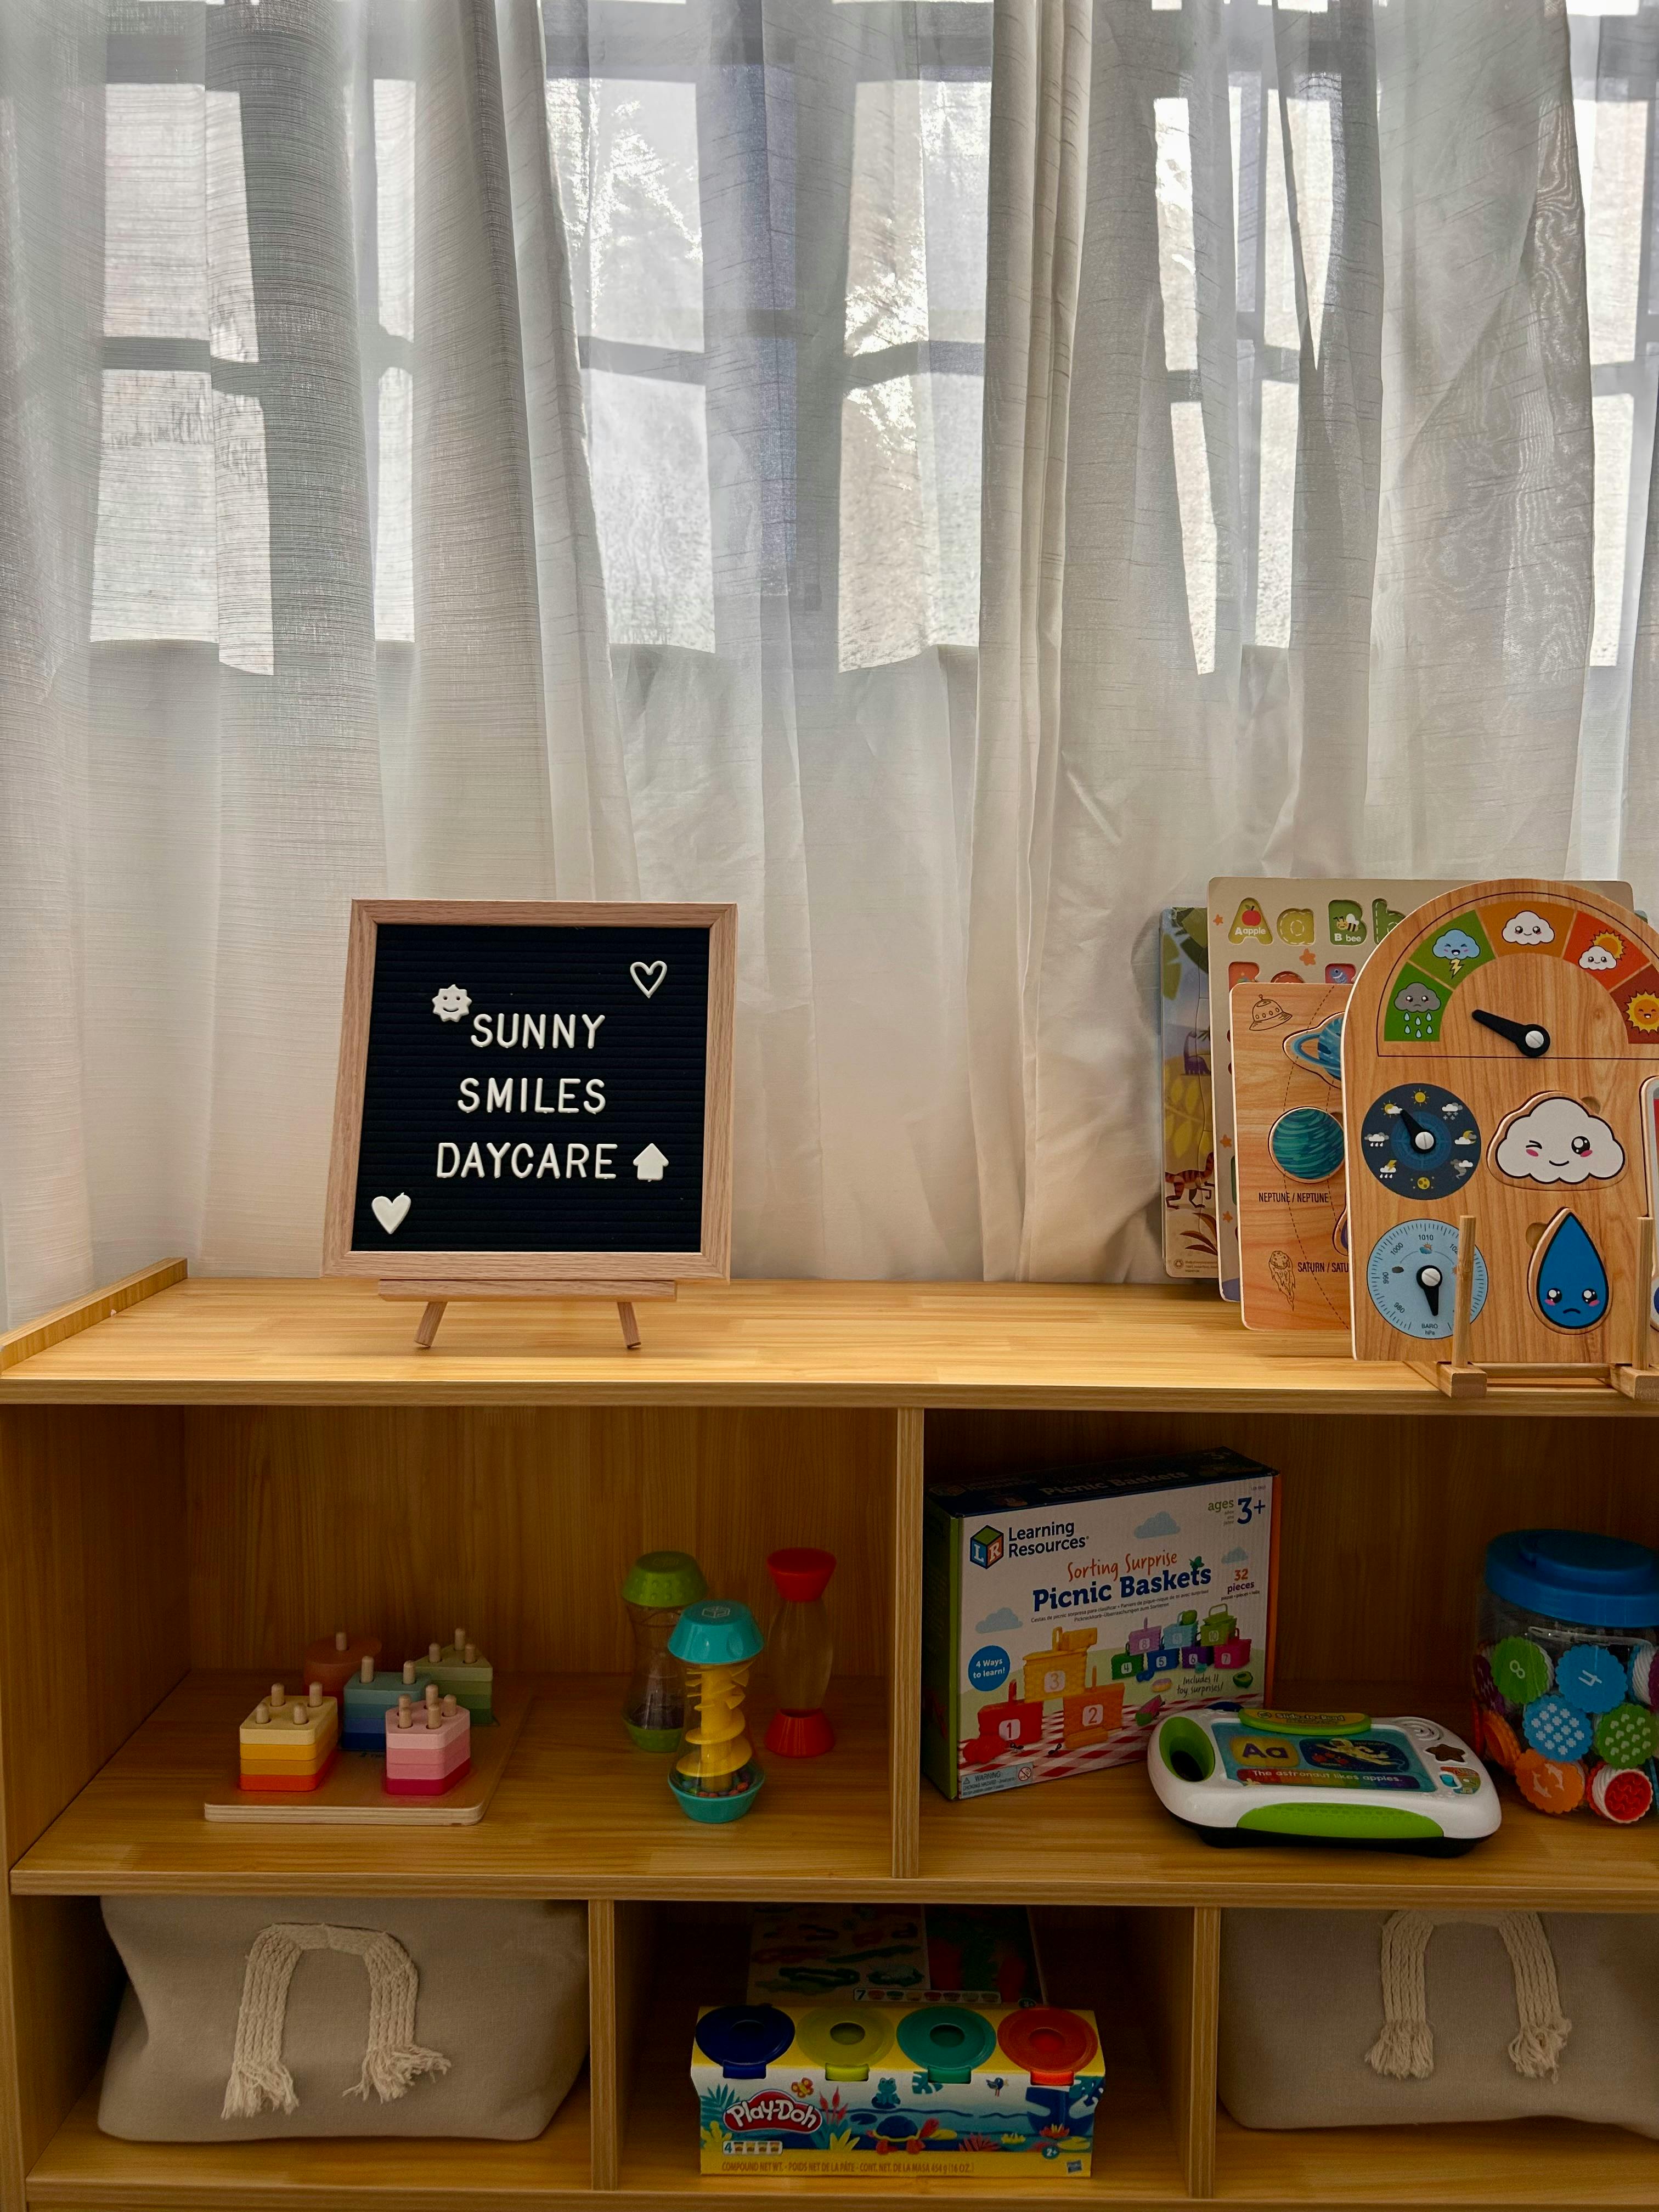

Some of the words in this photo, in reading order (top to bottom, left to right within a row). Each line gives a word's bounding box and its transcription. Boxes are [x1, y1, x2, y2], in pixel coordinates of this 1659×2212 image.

[1243, 927, 1266, 936] apple
[1334, 933, 1342, 941] B
[1346, 934, 1361, 943] bee
[470, 1013, 606, 1049] SUNNY
[458, 1077, 606, 1114] SMILES
[437, 1142, 618, 1179] DAYCARE
[1259, 1192, 1290, 1203] NEPTUNE
[1297, 1193, 1329, 1203] NEPTUNE
[1390, 1242, 1403, 1255] 1000
[1298, 1262, 1324, 1273] SATURN
[1393, 1302, 1405, 1314] 980
[1038, 1481, 1109, 1496] Picnic
[1109, 1471, 1189, 1487] Baskets
[1208, 1500, 1234, 1513] ages
[1237, 1497, 1265, 1524] 3+
[1009, 1521, 1074, 1542] Learning
[1068, 1558, 1118, 1582] Sorting
[1125, 1549, 1177, 1576] Surprise
[1234, 1568, 1248, 1581] 32
[1033, 1581, 1111, 1612] Picnic
[1120, 1567, 1211, 1598] Baskets
[1227, 1581, 1255, 1594] pieces
[1210, 1632, 1217, 1640] 10
[1142, 1639, 1148, 1648] 8
[983, 1658, 1003, 1668] Ways
[1124, 1664, 1129, 1672] 4
[1159, 1657, 1164, 1666] 5
[983, 1667, 1005, 1677] learn!
[1509, 1660, 1525, 1679] 8
[1050, 1673, 1059, 1690] 3
[1183, 1674, 1211, 1685] Includes
[1578, 1669, 1602, 1686] 4
[1177, 1685, 1188, 1695] toy
[1190, 1682, 1223, 1695] surprises!
[1088, 1708, 1097, 1723] 2
[1007, 1722, 1013, 1738] 1
[1243, 1743, 1288, 1758] Aa
[975, 1771, 1001, 1782] WARNING
[857, 1990, 866, 2000] 7
[726, 2099, 817, 2129] Play-Doh
[724, 2142, 732, 2153] 4
[1046, 2148, 1057, 2157] 2+
[721, 2161, 759, 2171] COMPOUND
[759, 2161, 771, 2171] NET
[788, 2161, 808, 2171] POIDS
[809, 2161, 821, 2171] NET
[821, 2162, 829, 2171] DE
[830, 2162, 839, 2171] LA
[840, 2160, 855, 2172] PÂTE
[860, 2163, 878, 2172] CONT.
[893, 2163, 901, 2172] DE
[902, 2163, 911, 2172] LA
[912, 2163, 930, 2172] MASA
[931, 2163, 942, 2172] 454
[943, 2164, 947, 2173] g
